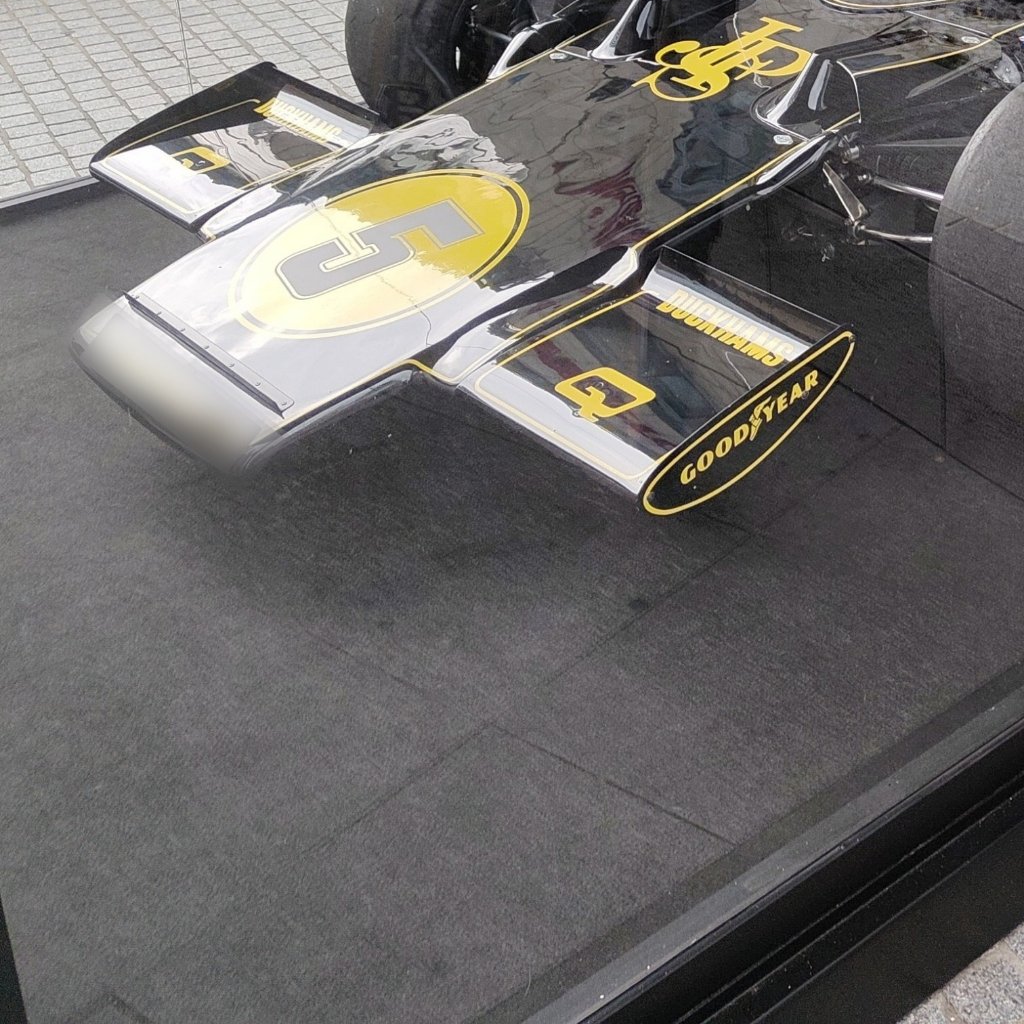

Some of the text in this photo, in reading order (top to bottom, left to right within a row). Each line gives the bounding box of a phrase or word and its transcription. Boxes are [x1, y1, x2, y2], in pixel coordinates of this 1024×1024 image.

[276, 197, 486, 300] 5
[656, 289, 796, 367] DUCKHAMS
[679, 369, 820, 485] GOODYEAR
